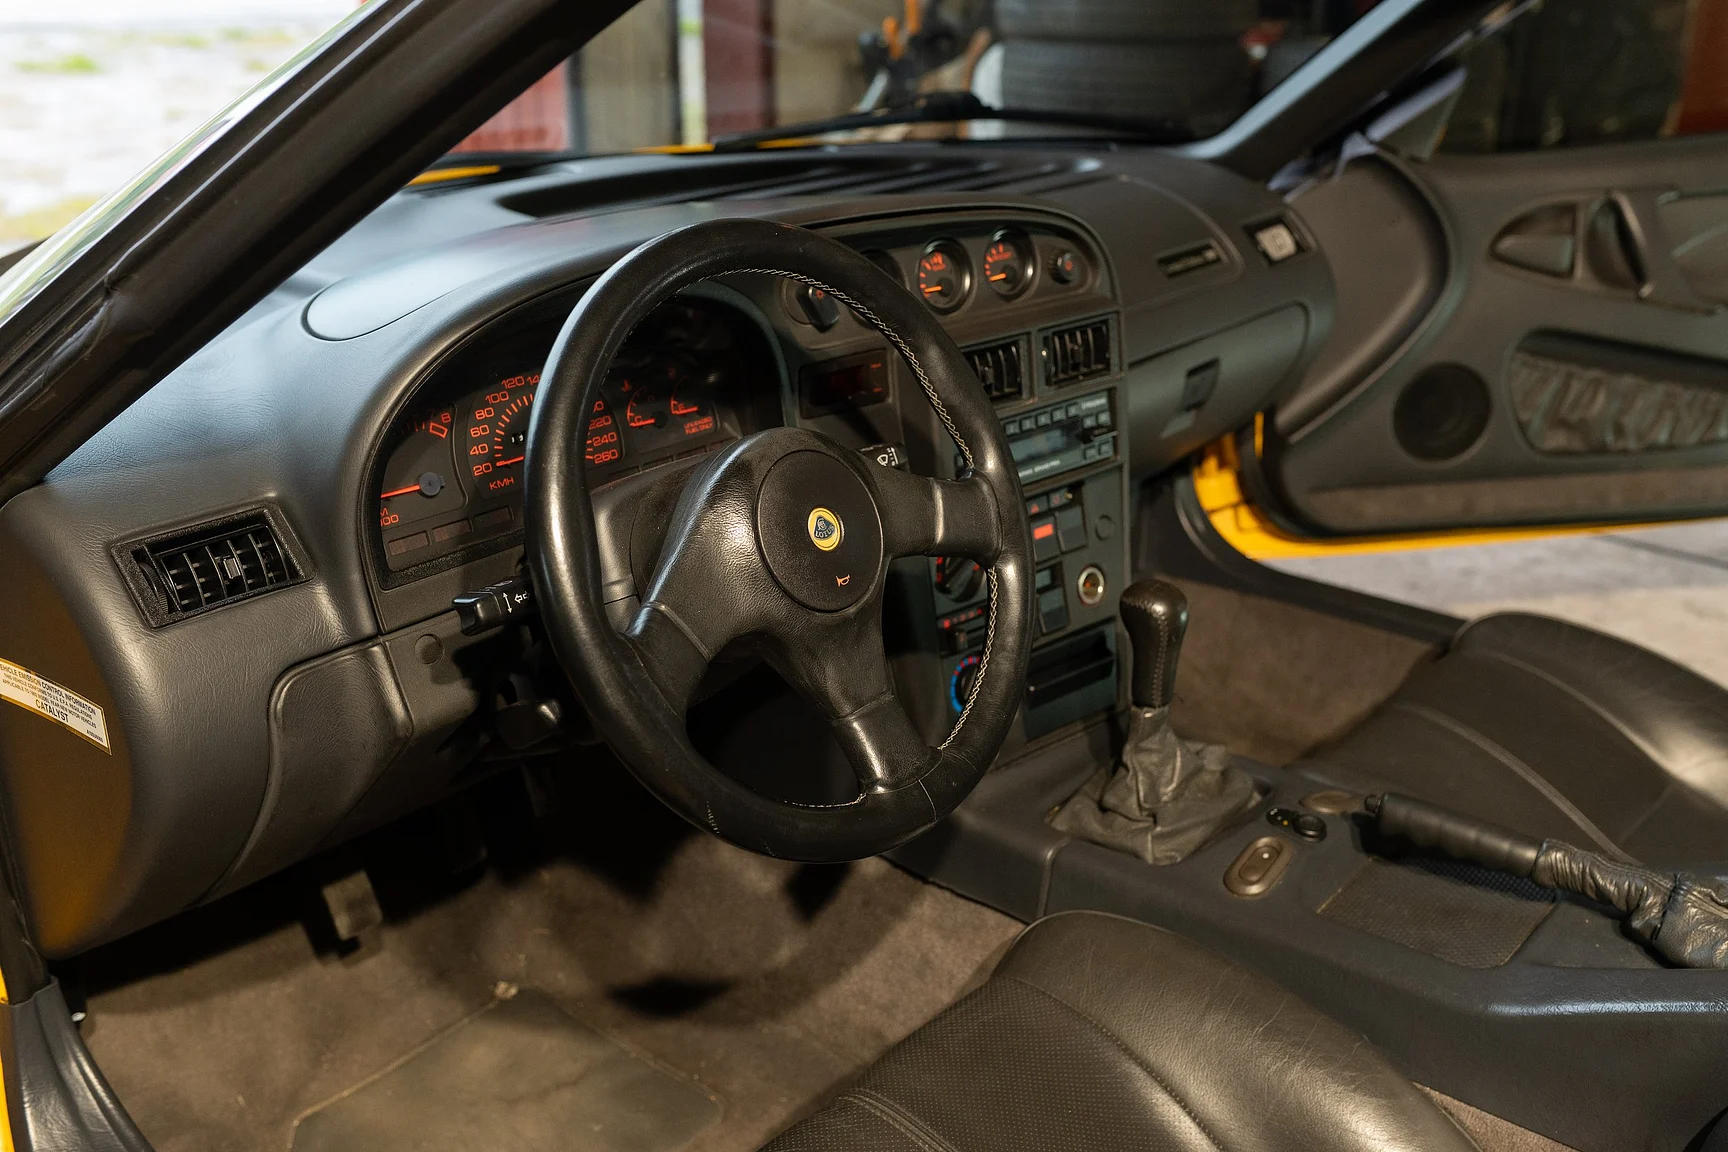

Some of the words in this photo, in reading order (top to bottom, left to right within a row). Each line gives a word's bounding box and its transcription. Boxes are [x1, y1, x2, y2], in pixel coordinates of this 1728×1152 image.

[501, 375, 525, 389] 120
[527, 374, 541, 386] 14
[485, 391, 509, 405] 100
[441, 412, 451, 423] 8
[475, 407, 495, 420] 80
[589, 415, 612, 430] 220
[470, 424, 490, 438] 60
[592, 431, 617, 447] 240
[469, 443, 489, 456] 40
[593, 449, 619, 464] 260
[472, 462, 493, 476] 20
[489, 476, 515, 490] KMH
[380, 514, 399, 526] 00
[815, 525, 835, 538] LOTUS
[0, 664, 18, 677] EHICLE
[42, 682, 65, 698] CONTROL
[65, 693, 96, 715] INFORMATION
[35, 699, 69, 723] CATALYST
